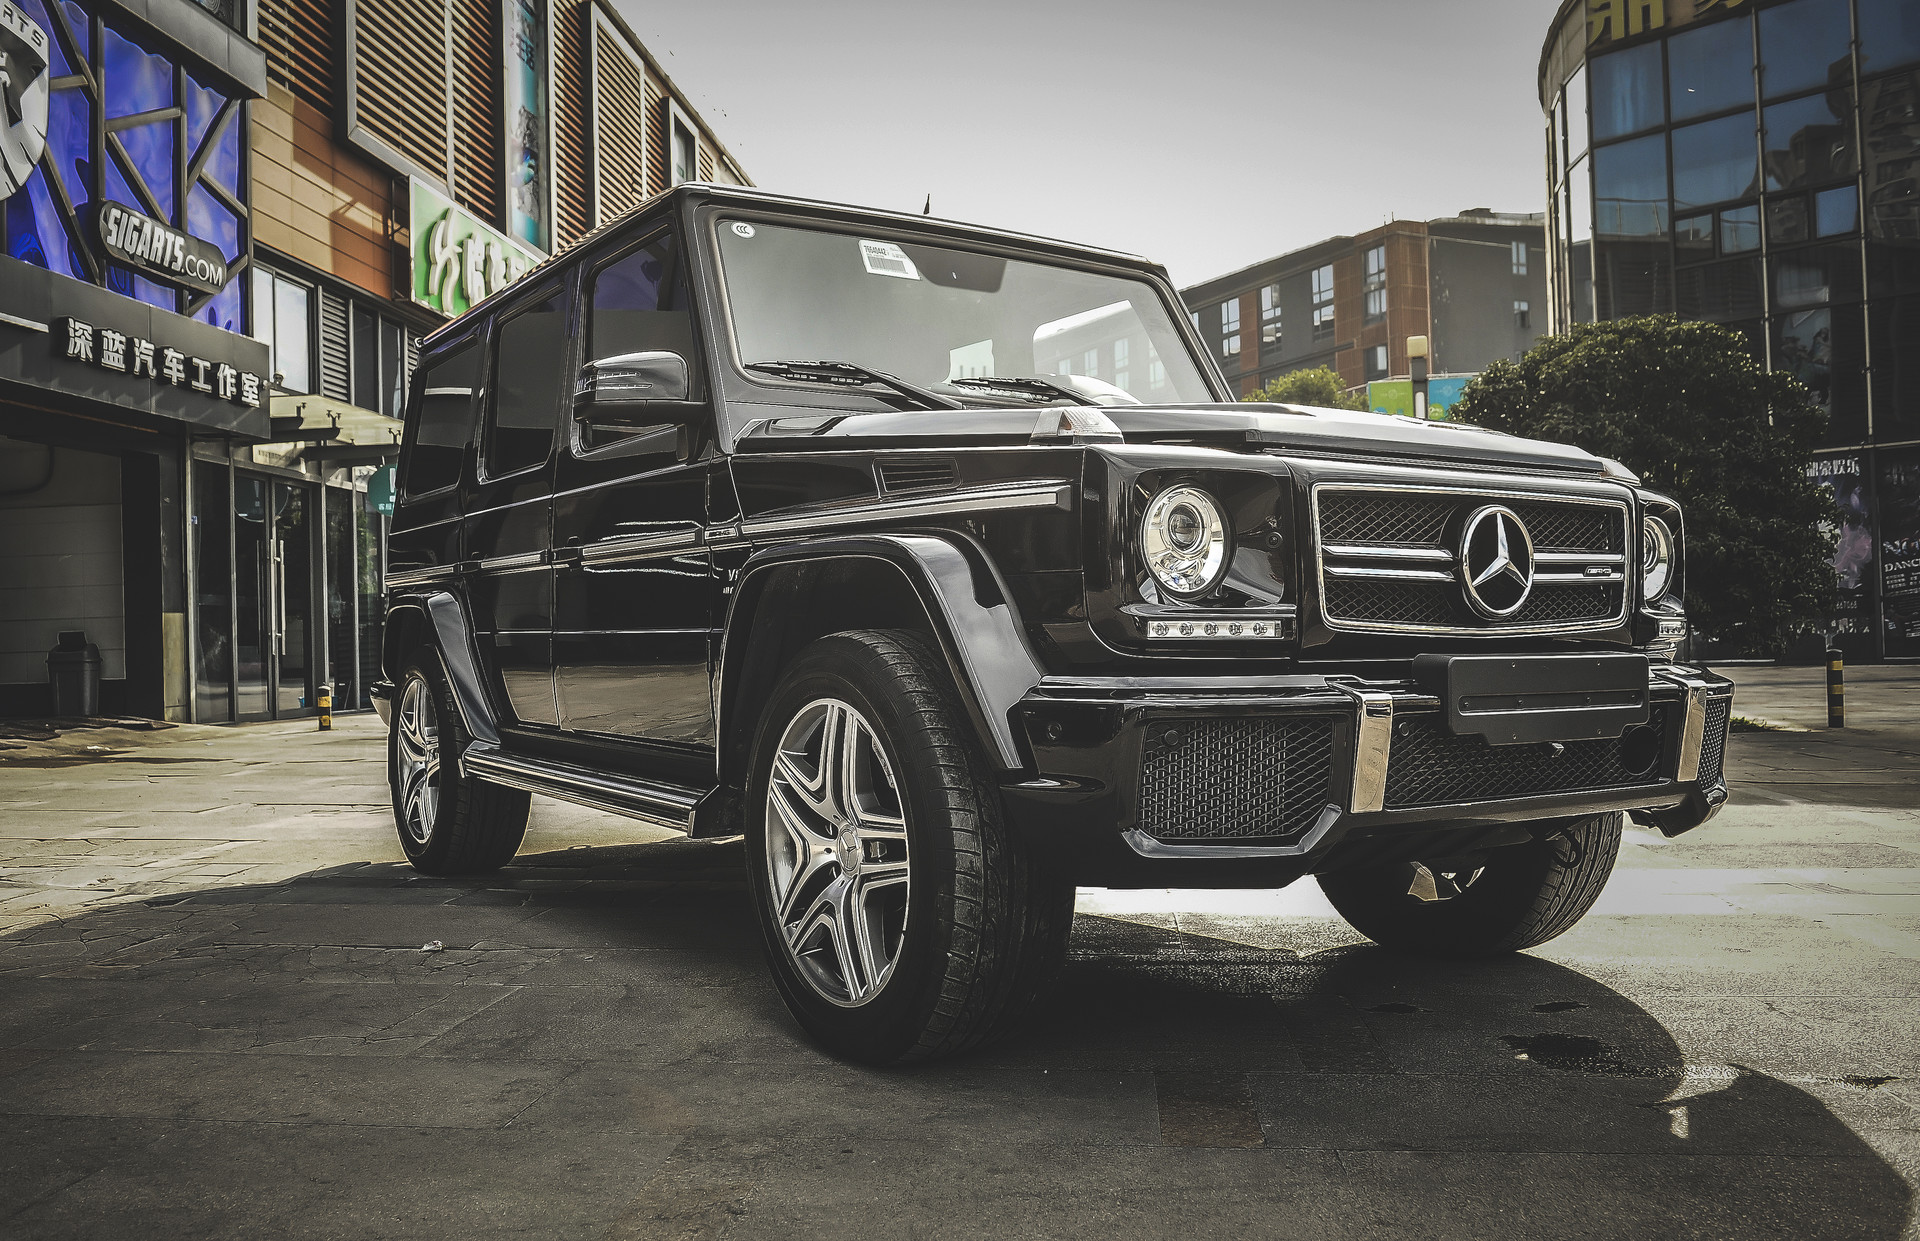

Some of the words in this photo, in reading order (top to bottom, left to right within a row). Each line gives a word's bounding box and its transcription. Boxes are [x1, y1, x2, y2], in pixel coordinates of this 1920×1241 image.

[106, 207, 224, 287] SIGARTS.COM
[67, 317, 261, 409] 深蓝汽车工作室
